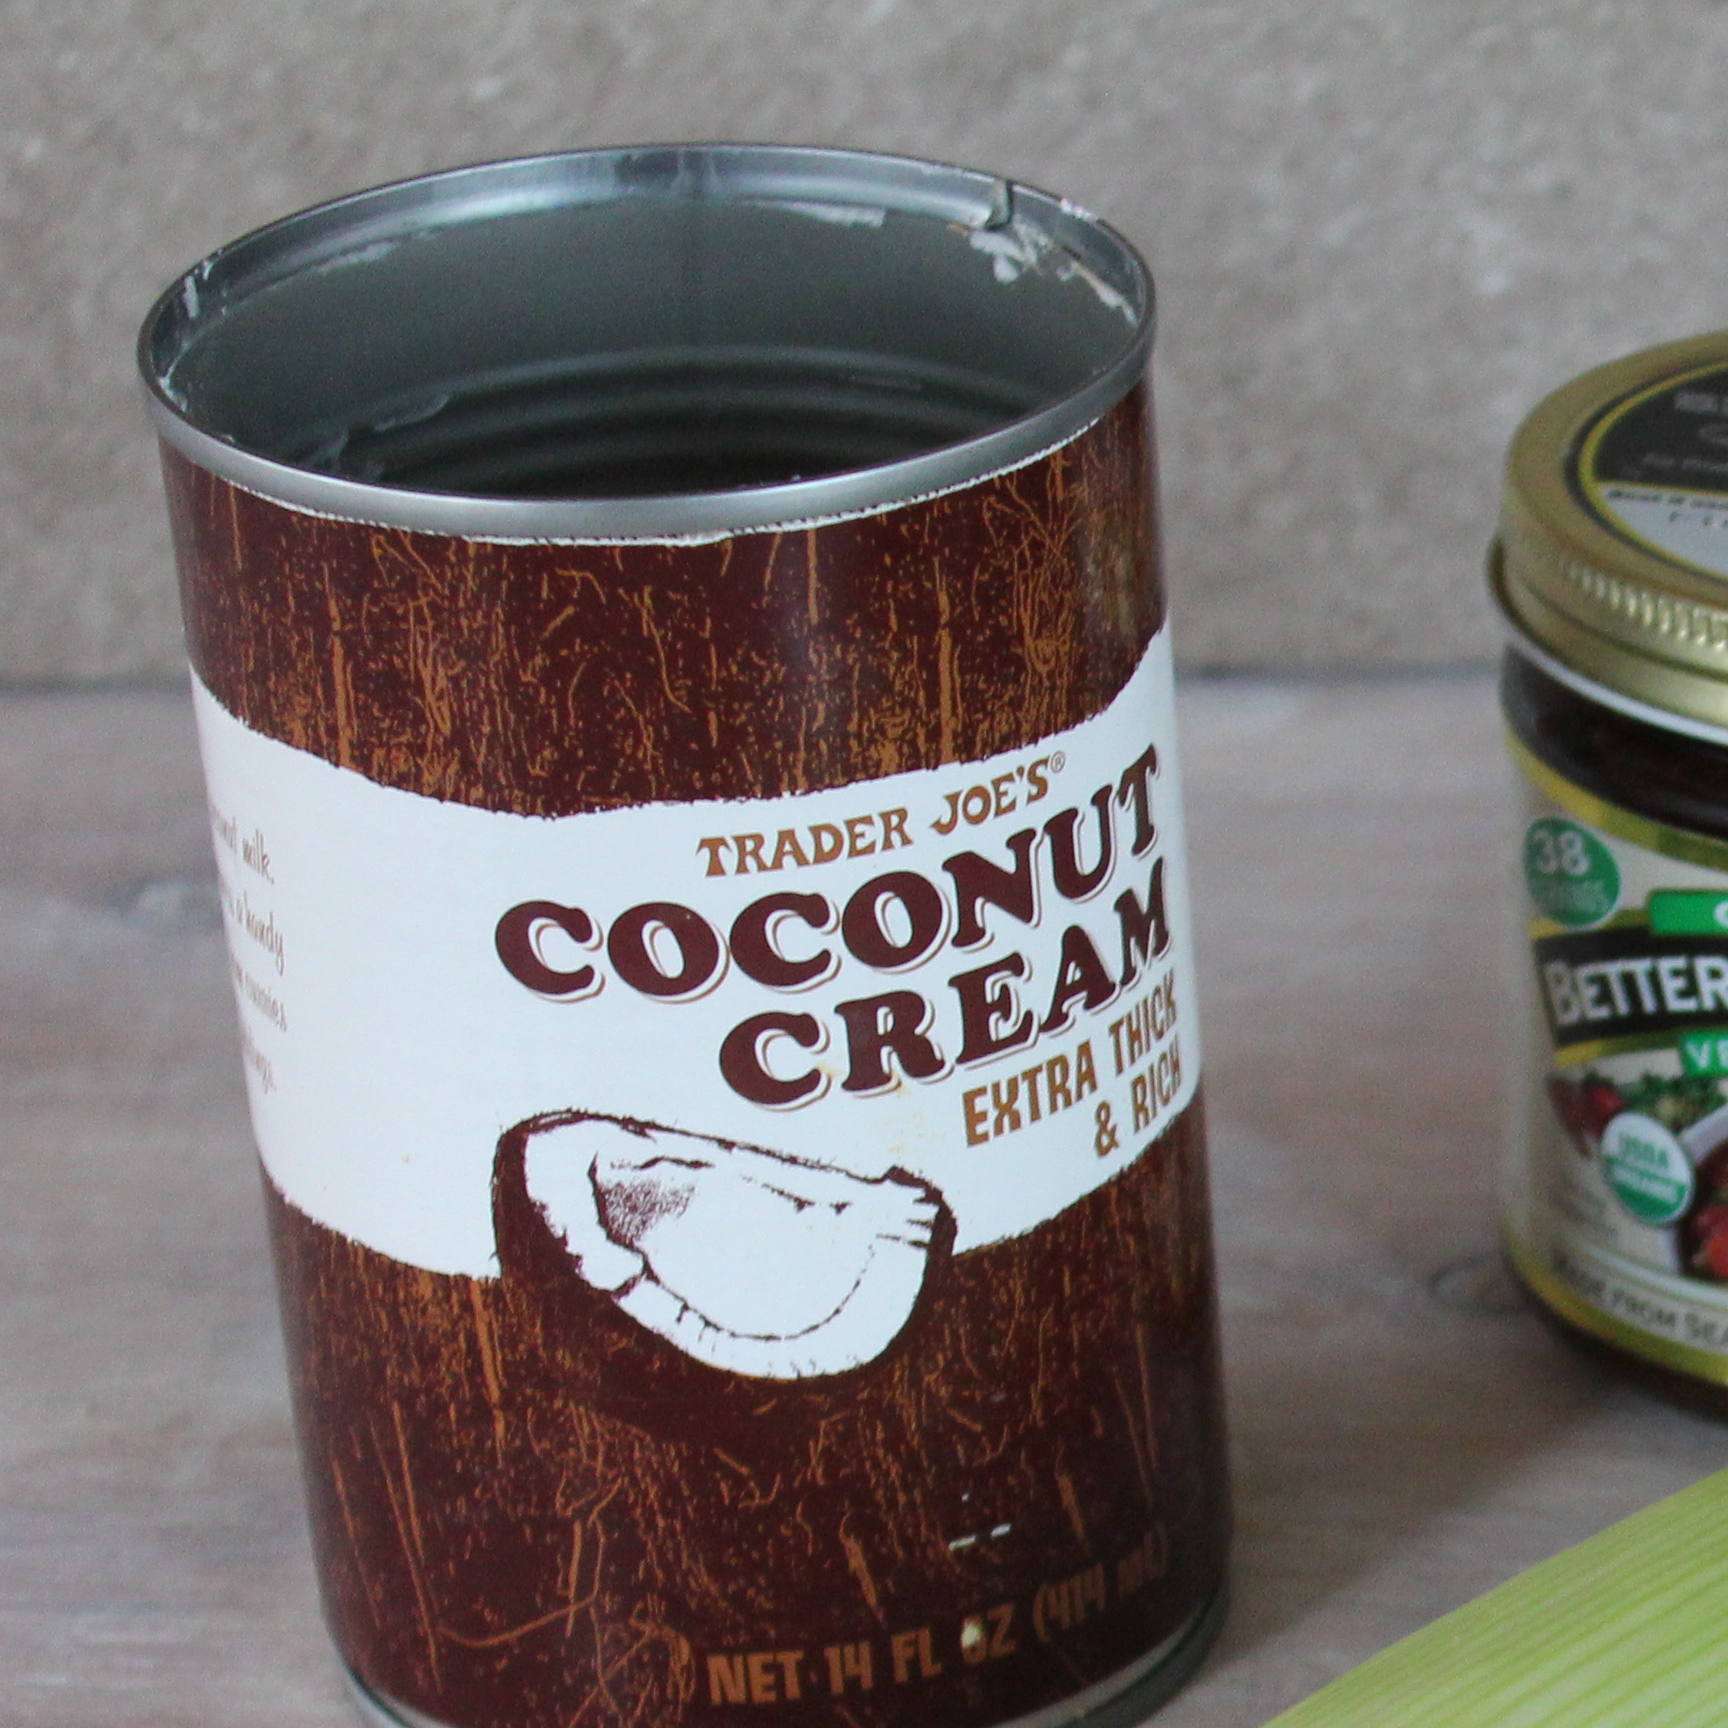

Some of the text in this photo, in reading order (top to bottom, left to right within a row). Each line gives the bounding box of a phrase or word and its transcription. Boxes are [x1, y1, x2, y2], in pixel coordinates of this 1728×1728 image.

[494, 743, 1160, 1002] COCONUT
[696, 807, 913, 878] TRADER
[1533, 828, 1591, 877] 38
[718, 856, 1171, 1112] CREAM
[961, 967, 1177, 1148] EXTRA THICK
[1093, 1031, 1182, 1157] & RICH
[708, 1646, 800, 1706] NET
[824, 1636, 874, 1695] 14
[890, 1626, 942, 1684] FL
[960, 1602, 1018, 1665] OZ
